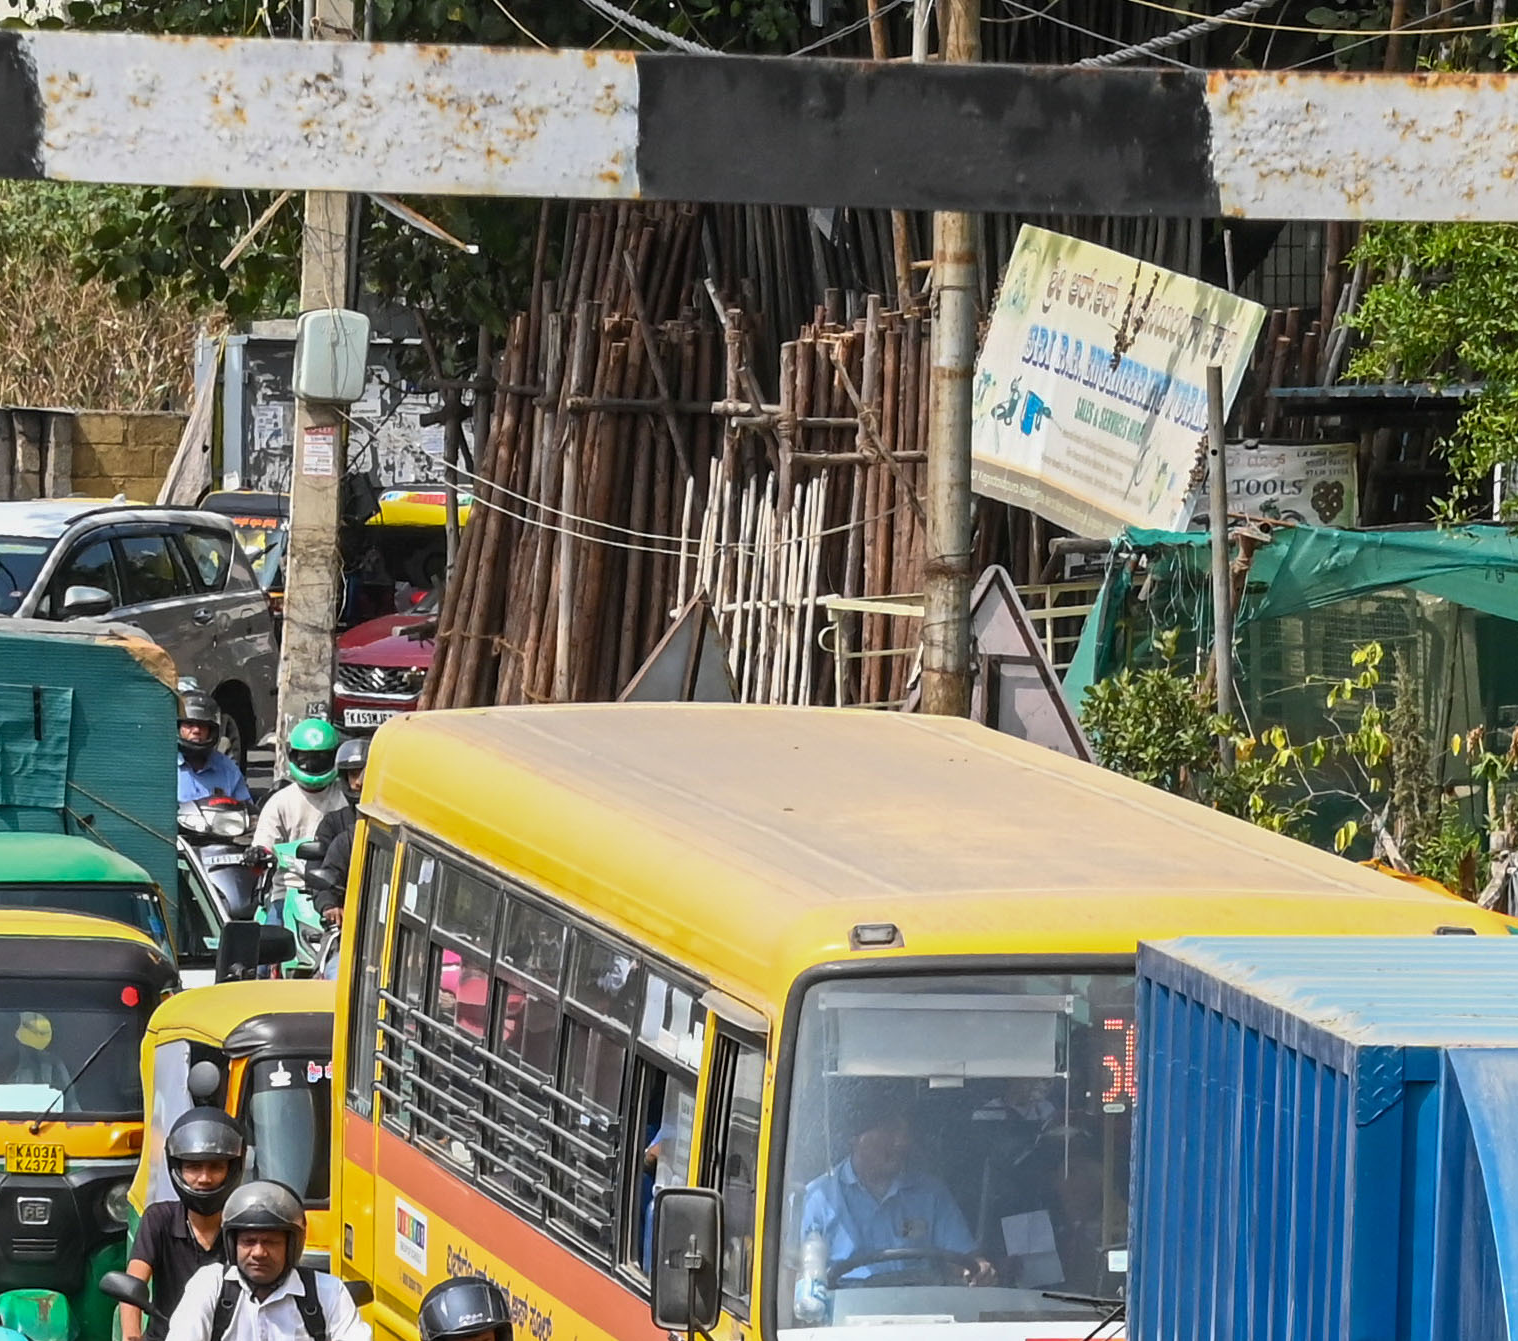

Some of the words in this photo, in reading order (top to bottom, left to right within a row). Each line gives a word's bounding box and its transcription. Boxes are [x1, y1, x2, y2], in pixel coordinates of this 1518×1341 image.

[1233, 478, 1304, 497] TOOLS
[16, 1146, 58, 1159] KA03A
[16, 1159, 58, 1171] K4372
